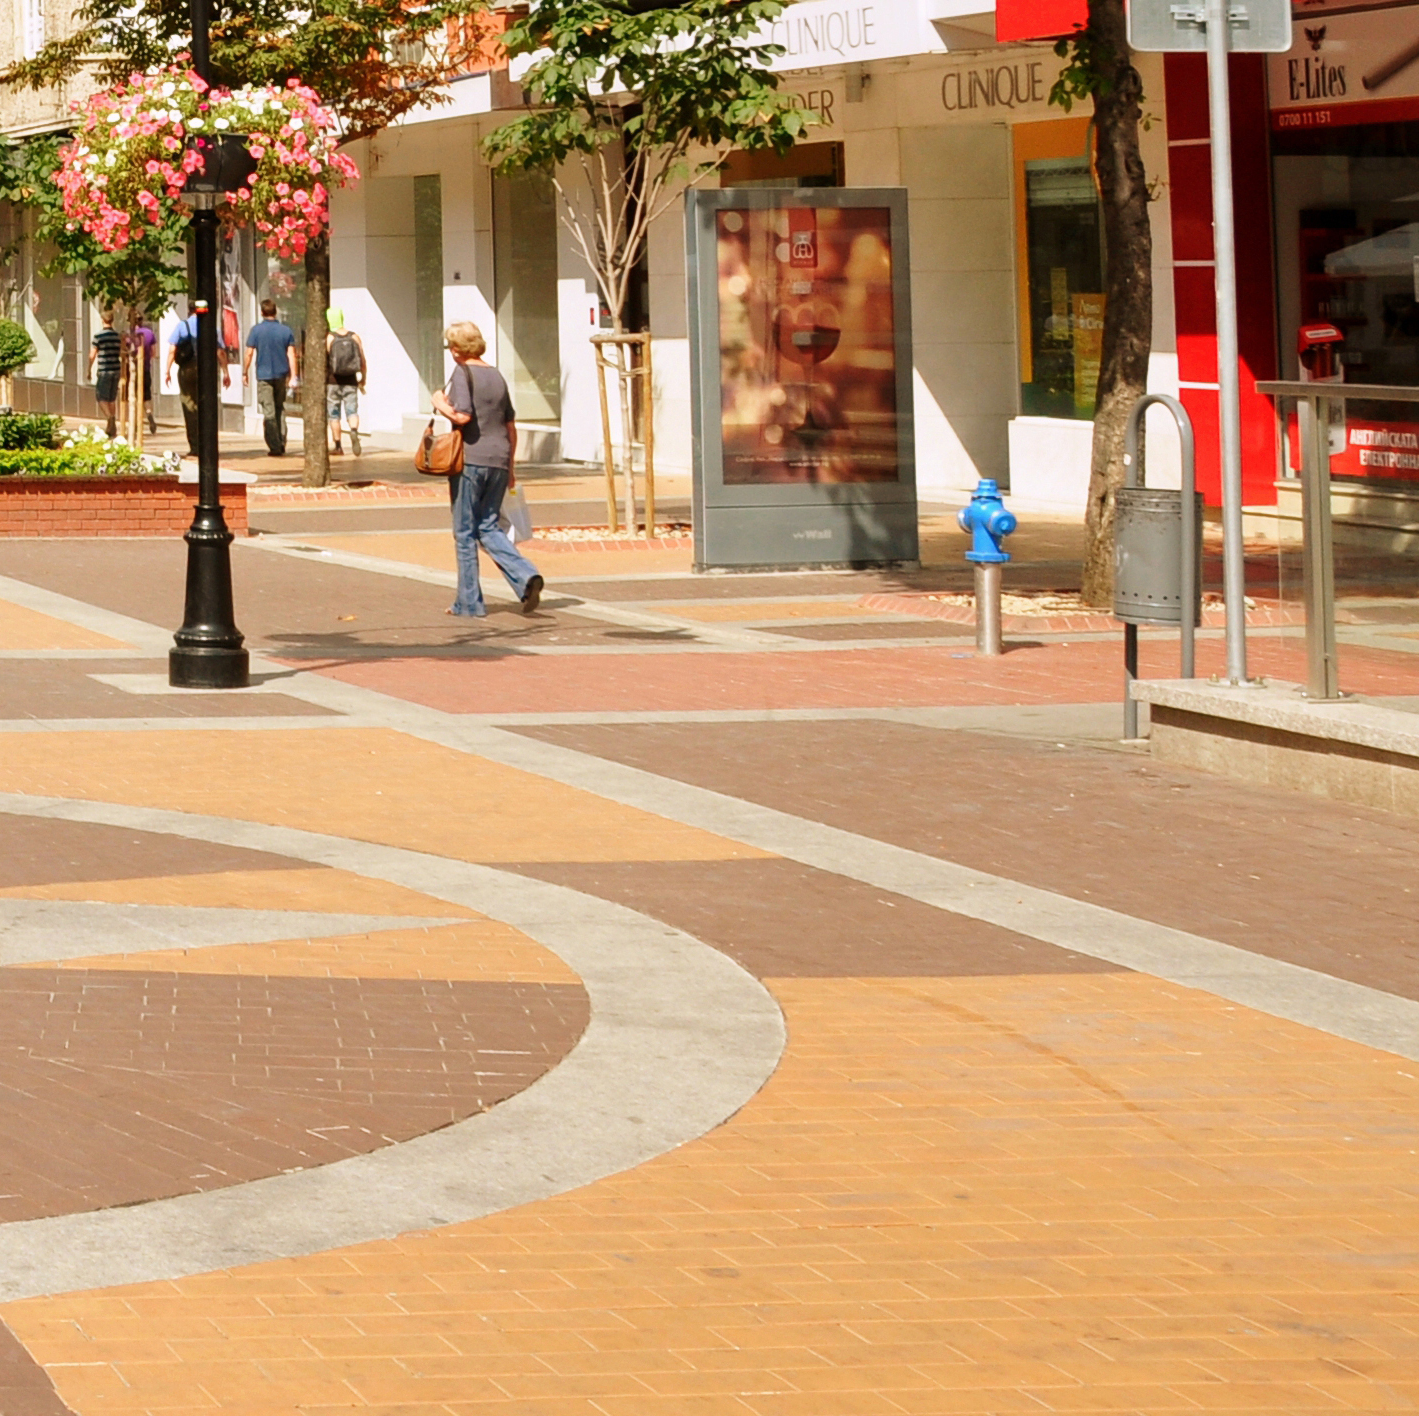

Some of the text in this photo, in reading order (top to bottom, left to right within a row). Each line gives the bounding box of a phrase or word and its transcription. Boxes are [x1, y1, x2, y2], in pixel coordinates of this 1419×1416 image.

[770, 5, 876, 58] CLINIQUE
[941, 61, 1044, 112] CLINIQUE
[1287, 56, 1347, 101] E-Lites
[1278, 114, 1301, 127] 0700
